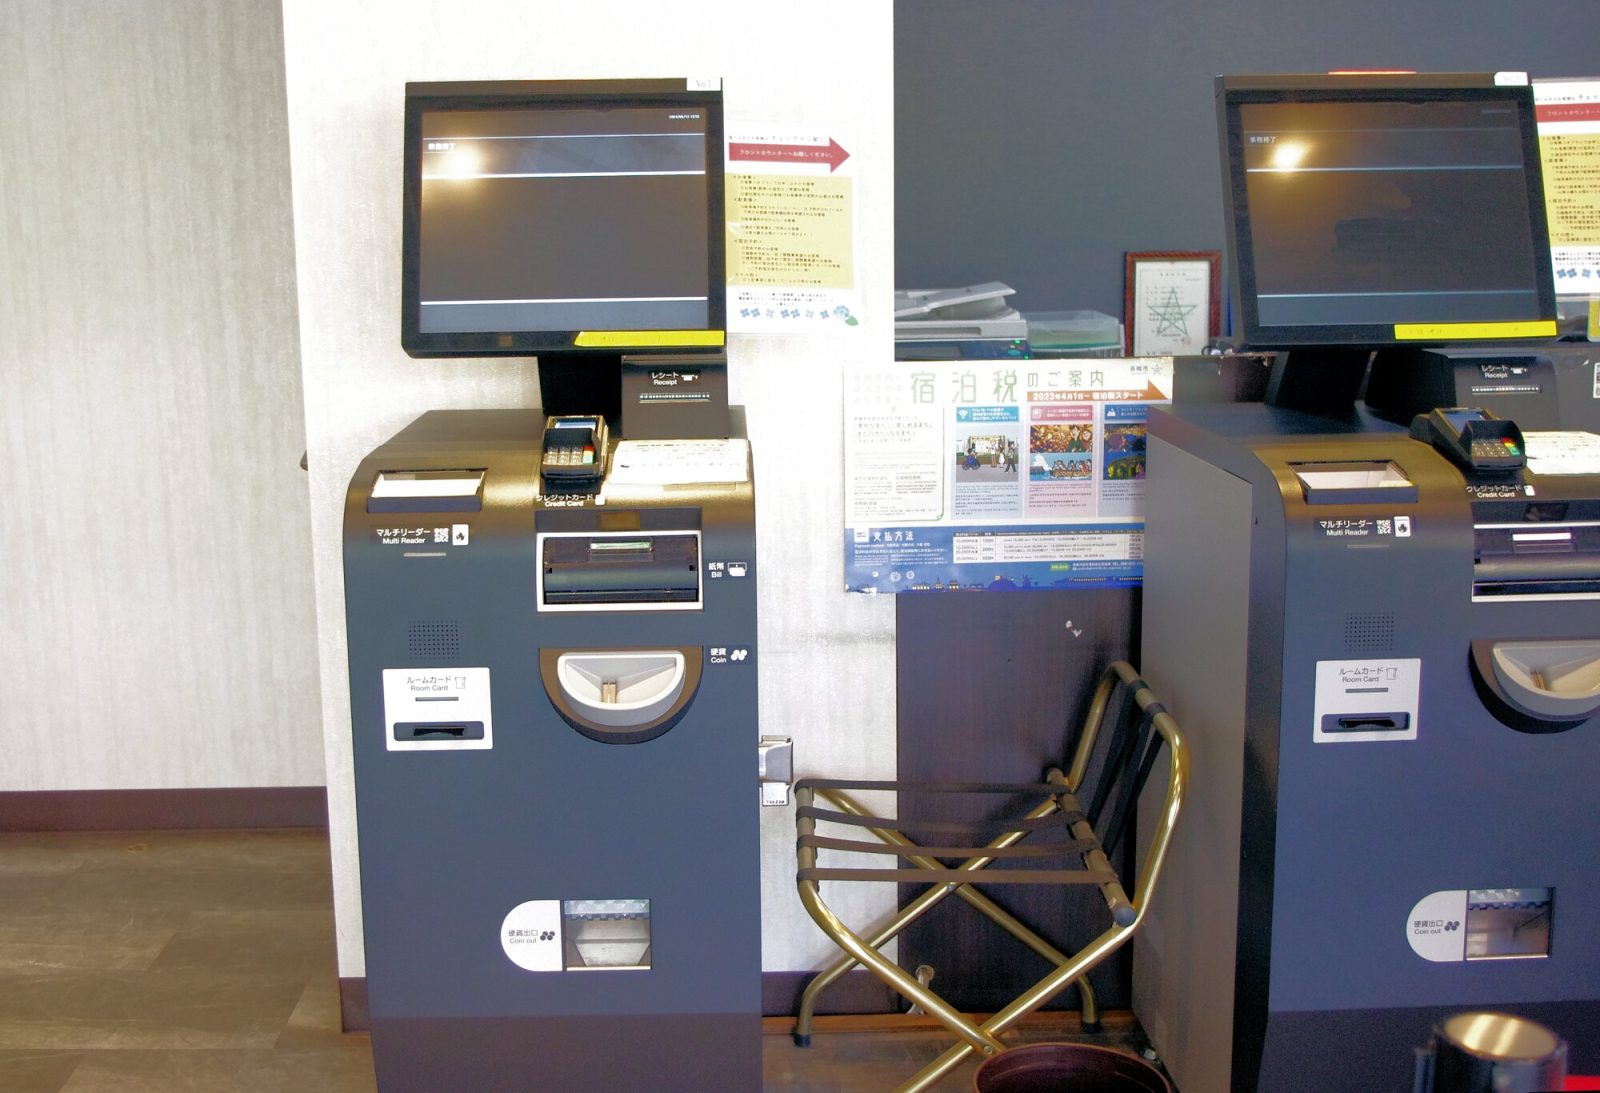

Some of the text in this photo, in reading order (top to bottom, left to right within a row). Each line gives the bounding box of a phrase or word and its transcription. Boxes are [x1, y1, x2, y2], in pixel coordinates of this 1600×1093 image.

[1481, 365, 1509, 373] レシート
[651, 371, 680, 380] レシート
[911, 370, 1104, 404] 宿泊税のご案内
[1466, 484, 1522, 493] クレジットカード
[535, 493, 594, 502] クレジットカード
[1320, 519, 1373, 528] マルチリーダー
[376, 527, 431, 537] マルチリーダー
[401, 536, 426, 544] Reader
[1339, 667, 1384, 676] ルームカード
[406, 675, 452, 684] ルームカード
[1413, 919, 1444, 928] 硬貨出口
[508, 929, 539, 937] 硬貨出口
